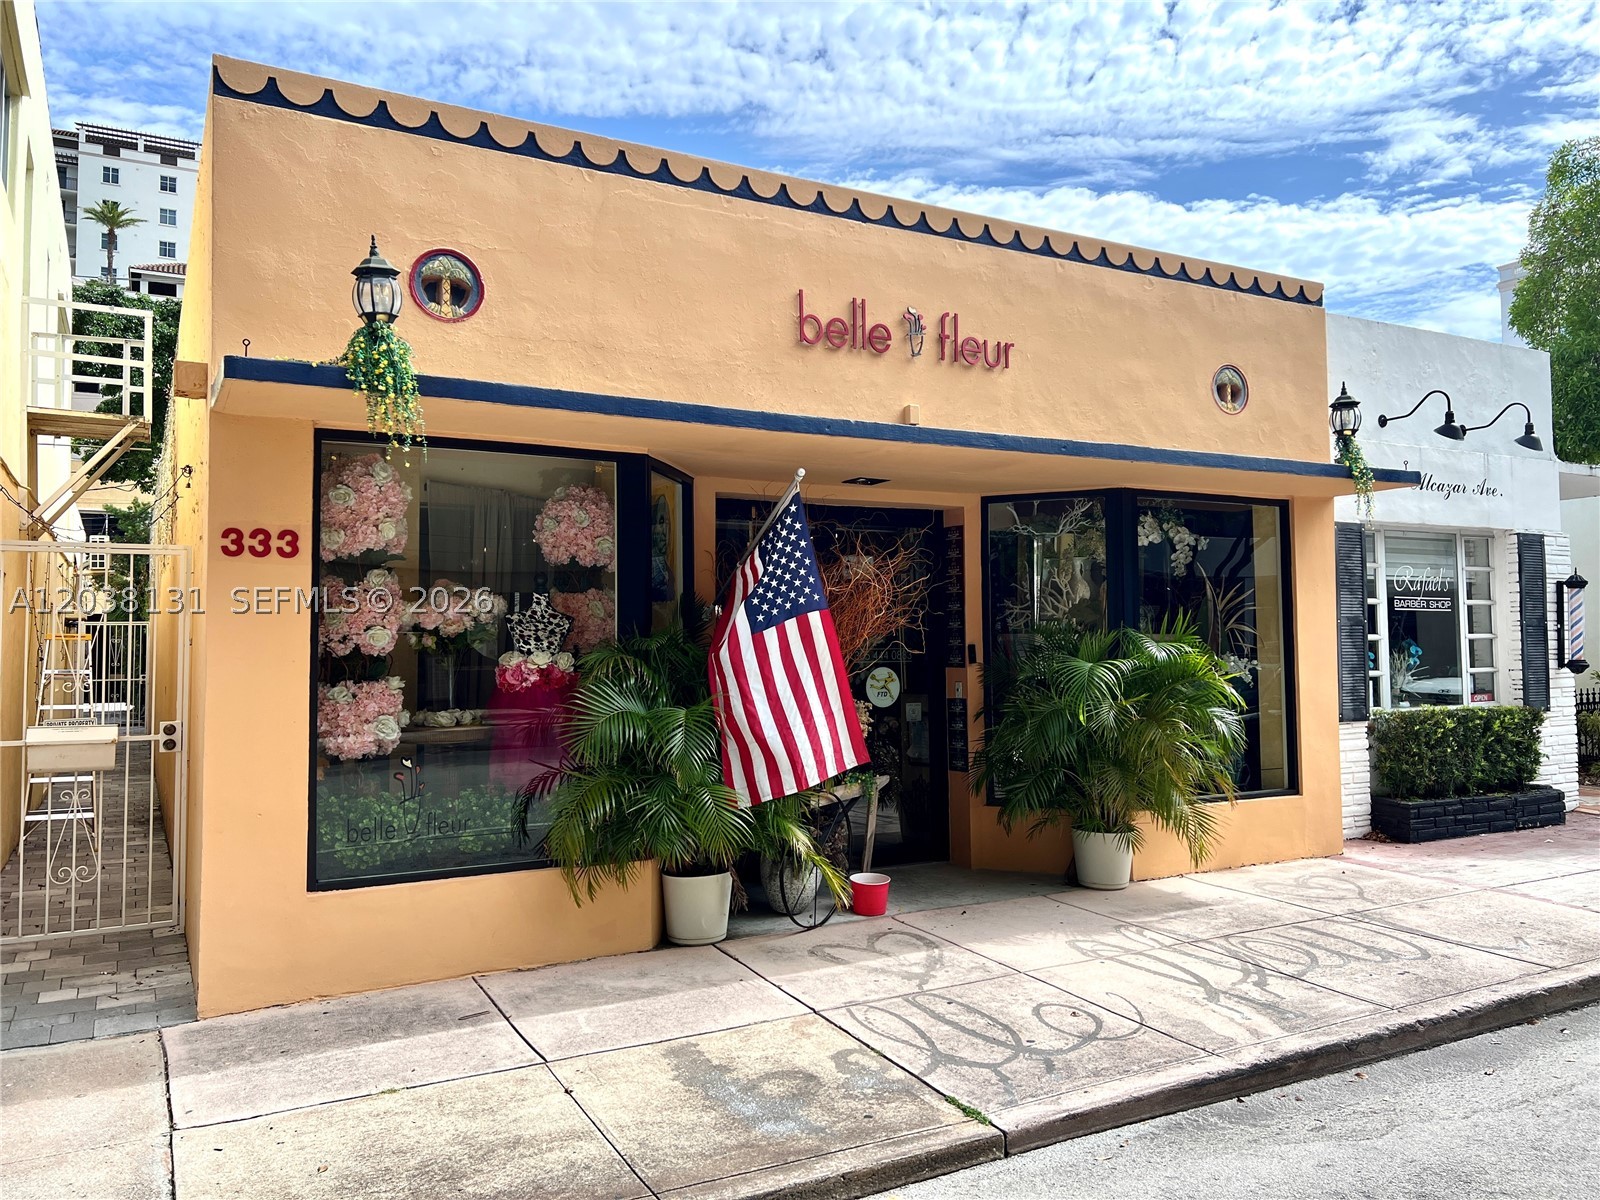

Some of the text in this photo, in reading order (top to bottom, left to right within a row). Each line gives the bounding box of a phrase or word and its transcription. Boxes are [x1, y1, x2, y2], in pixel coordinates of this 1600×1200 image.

[798, 289, 1015, 369] belle fleur
[1411, 472, 1503, 500] Alcazar Ave.
[220, 527, 300, 559] 333
[1393, 565, 1450, 600] Rafael's
[1394, 599, 1452, 609] BARBER SHOP
[1473, 694, 1488, 702] OPEN
[346, 811, 471, 843] belle fleur
